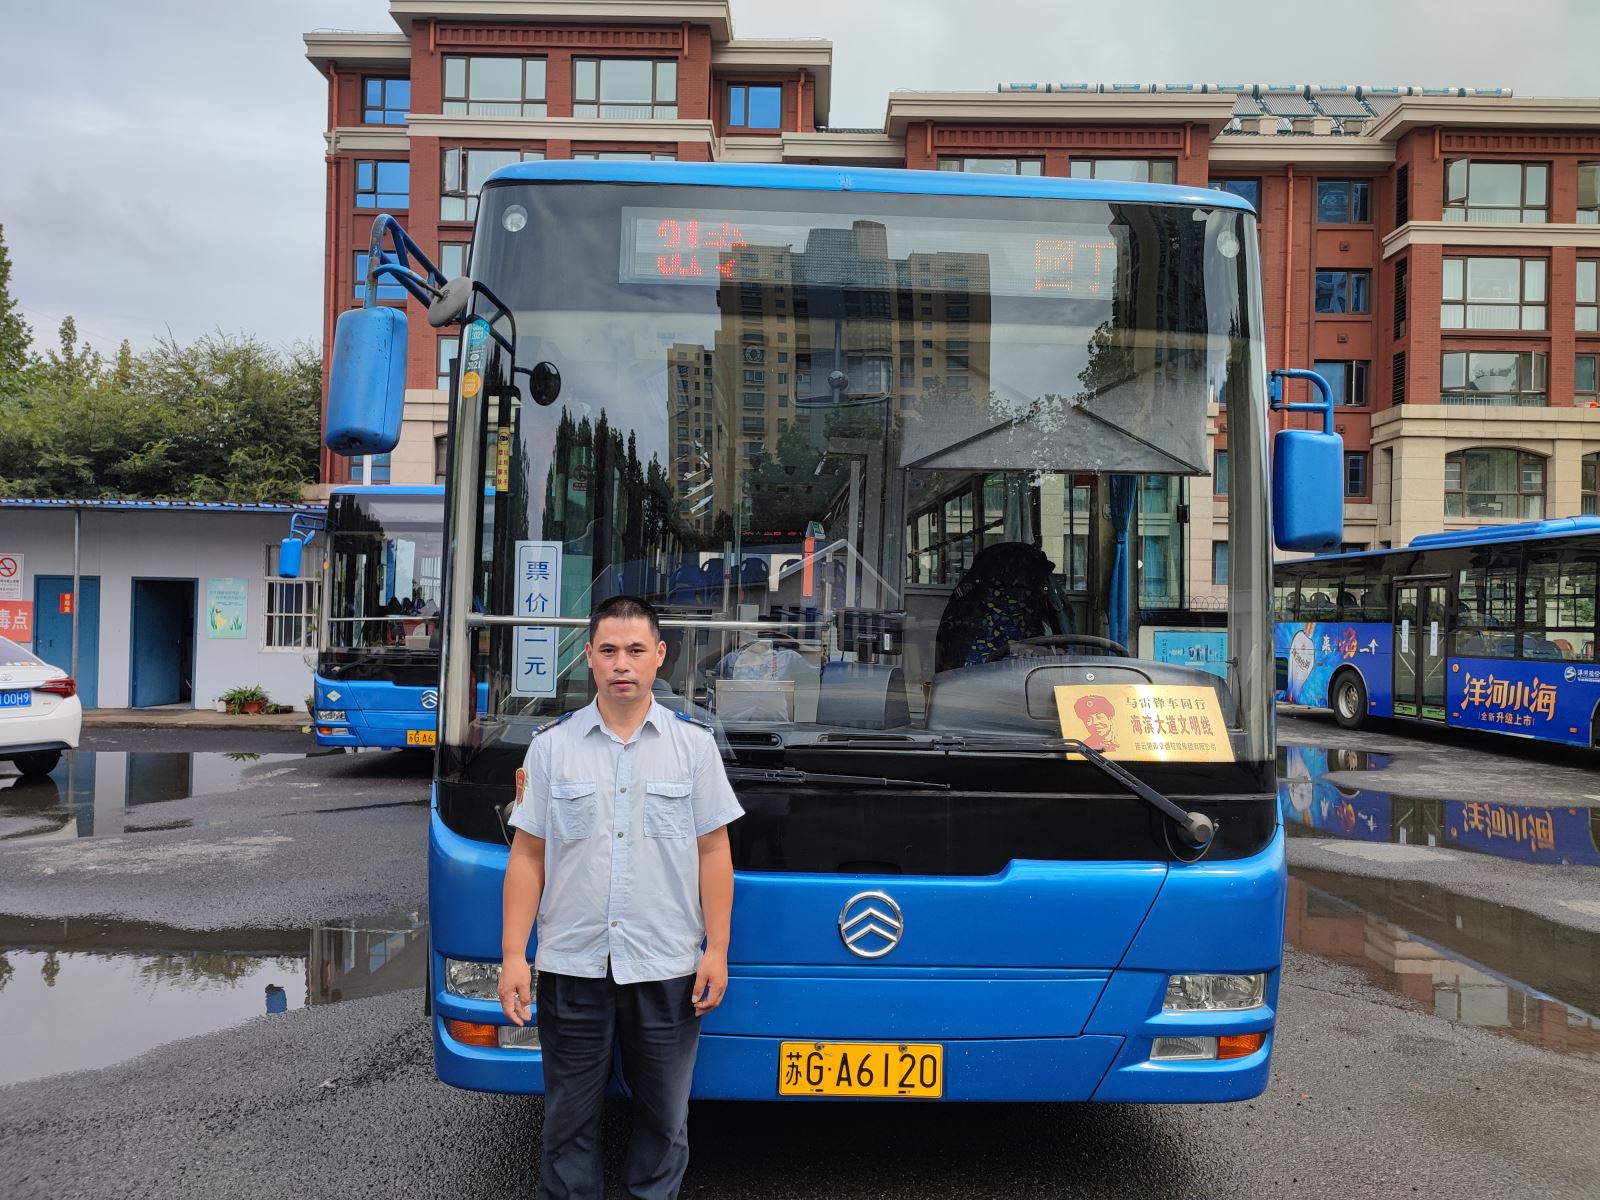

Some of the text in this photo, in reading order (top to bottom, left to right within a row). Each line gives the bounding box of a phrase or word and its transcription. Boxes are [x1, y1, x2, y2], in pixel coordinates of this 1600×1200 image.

[525, 561, 550, 676] 票价二元
[0, 692, 30, 705] 00H9
[1126, 697, 1206, 710] 与雷锋车同行
[1460, 671, 1558, 721] 洋河小海
[1130, 714, 1214, 736] 海滨大道文明线
[1481, 711, 1532, 726] 全新升级上市
